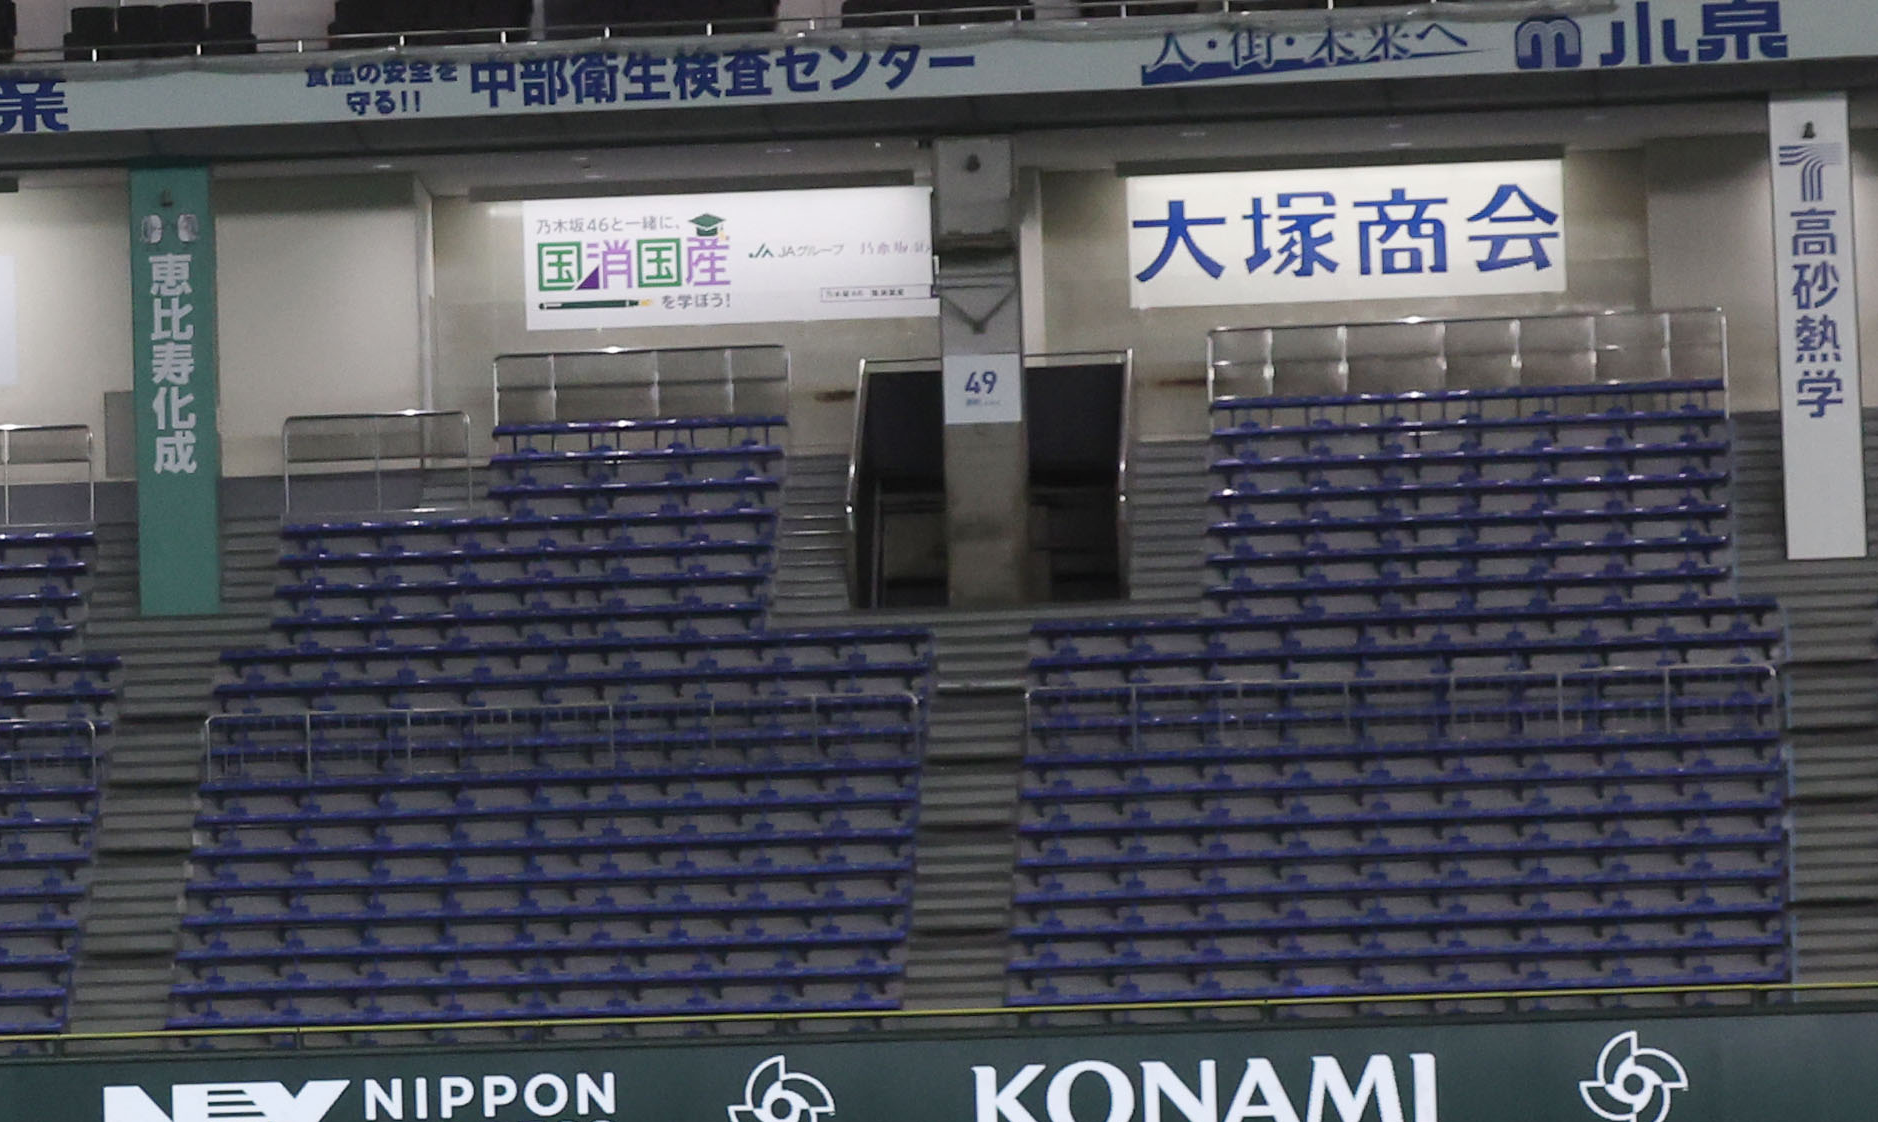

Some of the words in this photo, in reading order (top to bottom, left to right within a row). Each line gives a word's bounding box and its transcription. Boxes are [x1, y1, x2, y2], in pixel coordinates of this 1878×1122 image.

[1598, 2, 1790, 65] 小泉
[305, 60, 458, 89] 食品の安全を
[471, 45, 976, 108] 中部衛生検査センター
[537, 236, 731, 291] 国消国産
[1133, 183, 1561, 283] 大塚商会
[1790, 208, 1844, 419] 高砂熱学
[148, 253, 197, 475] 恵比寿化成
[965, 370, 997, 394] 49
[364, 1071, 616, 1122] NIPPON
